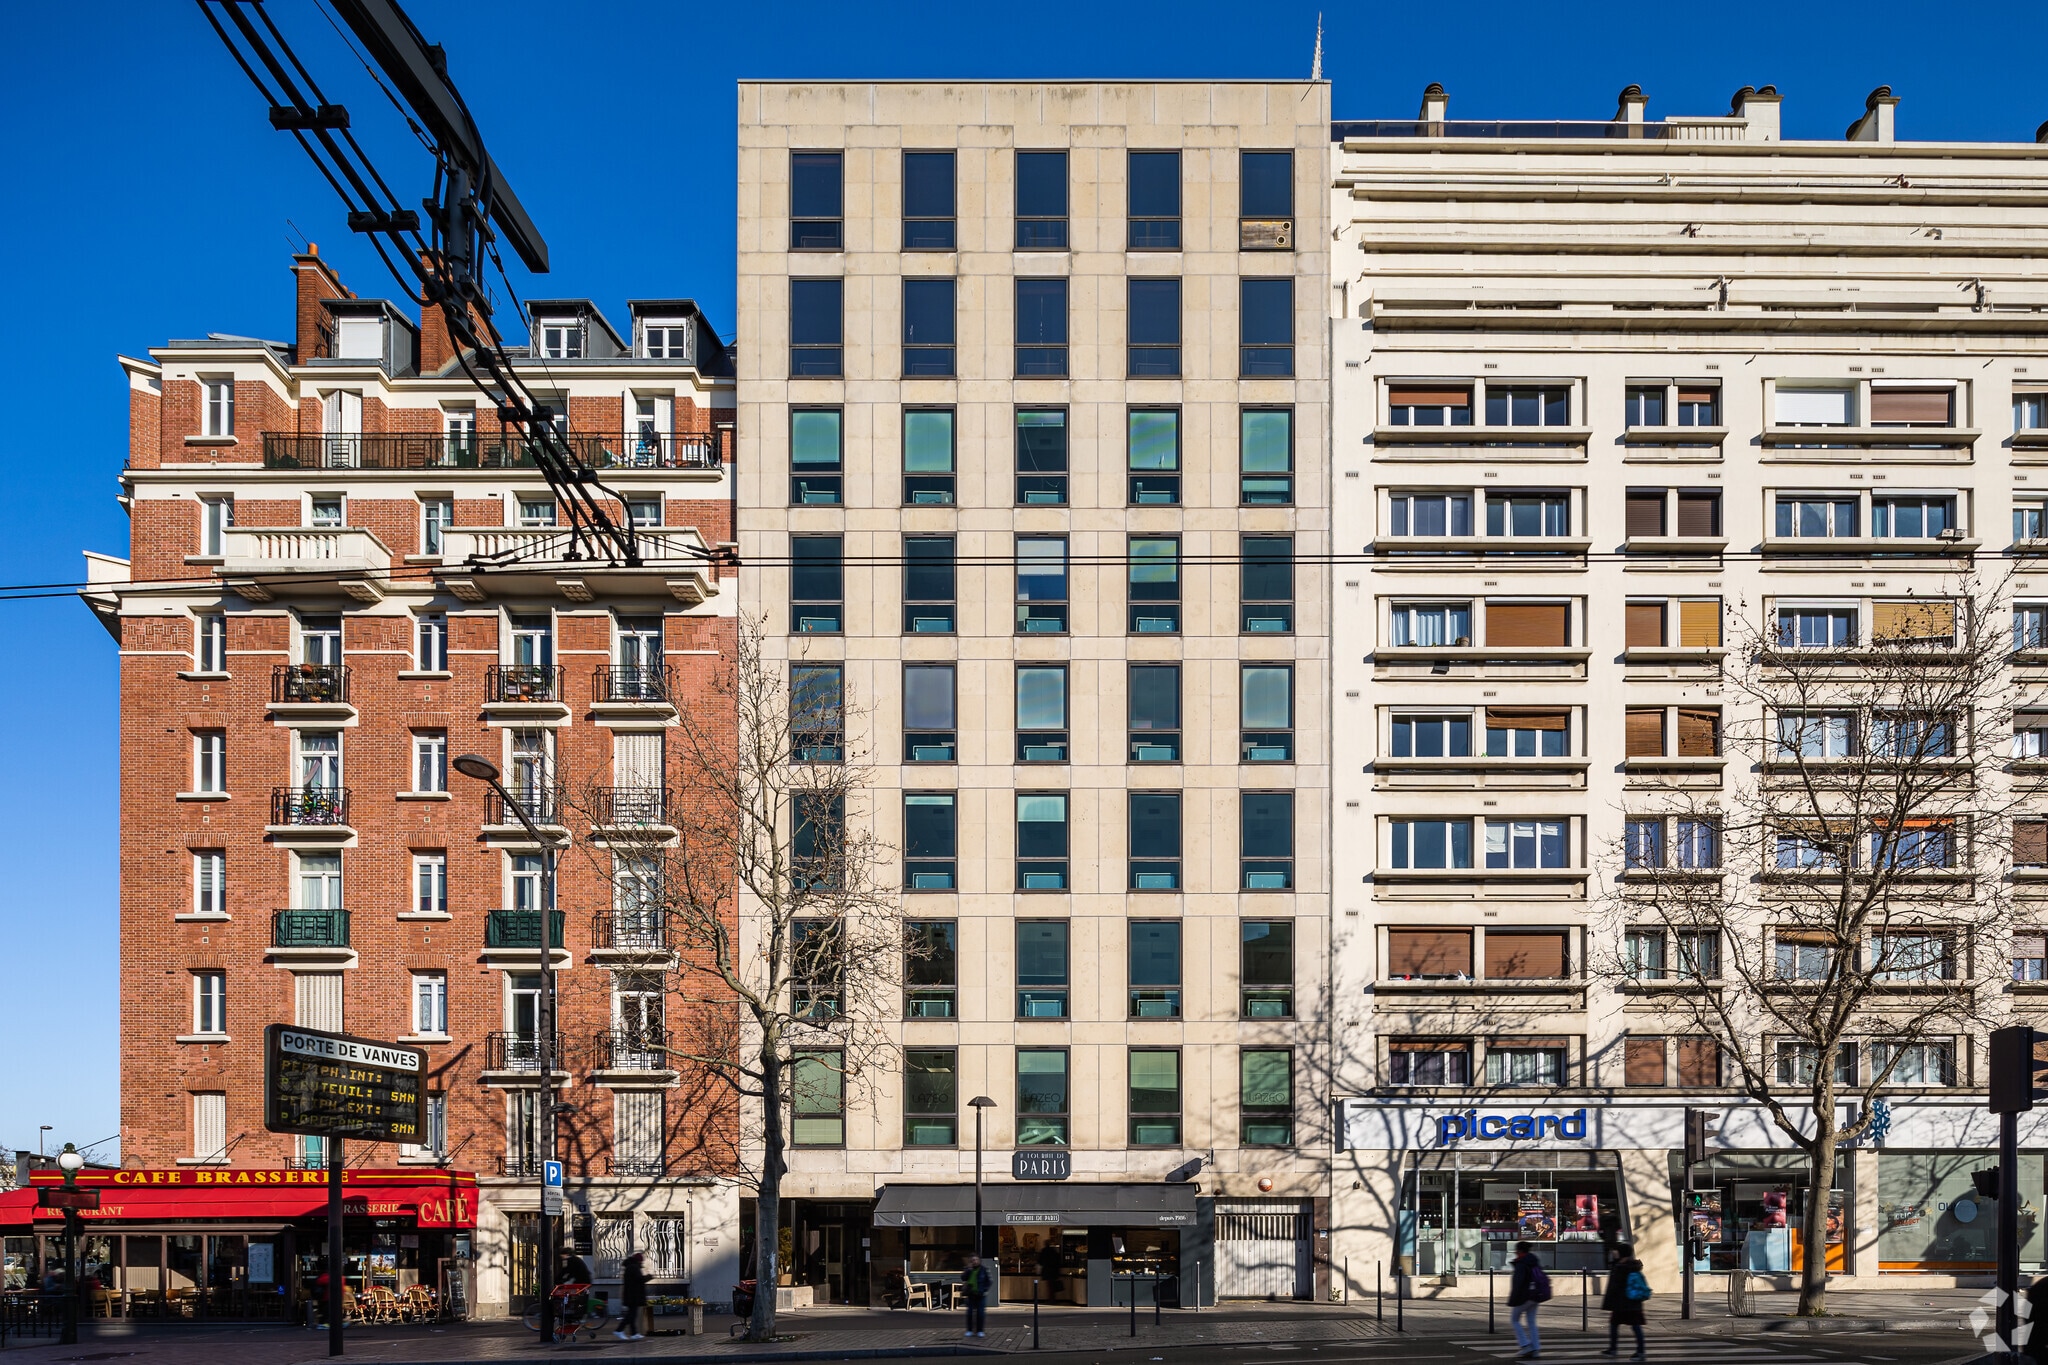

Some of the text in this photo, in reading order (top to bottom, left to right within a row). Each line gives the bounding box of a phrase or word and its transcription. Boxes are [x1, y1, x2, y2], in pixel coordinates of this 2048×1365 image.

[283, 1034, 417, 1067] PORTE DE VANVES
[390, 1091, 415, 1103] 5MN
[912, 1093, 948, 1104] LAZEO
[1024, 1093, 1061, 1103] LAZEO
[1248, 1092, 1286, 1103] LAZEO
[390, 1123, 415, 1135] 3MN
[1439, 1108, 1586, 1146] picard
[1019, 1159, 1066, 1175] PARIS
[113, 1171, 182, 1184] CAFE
[549, 1165, 558, 1182] P
[343, 1203, 399, 1214] RASSERIE
[420, 1193, 470, 1223] CAFÉ
